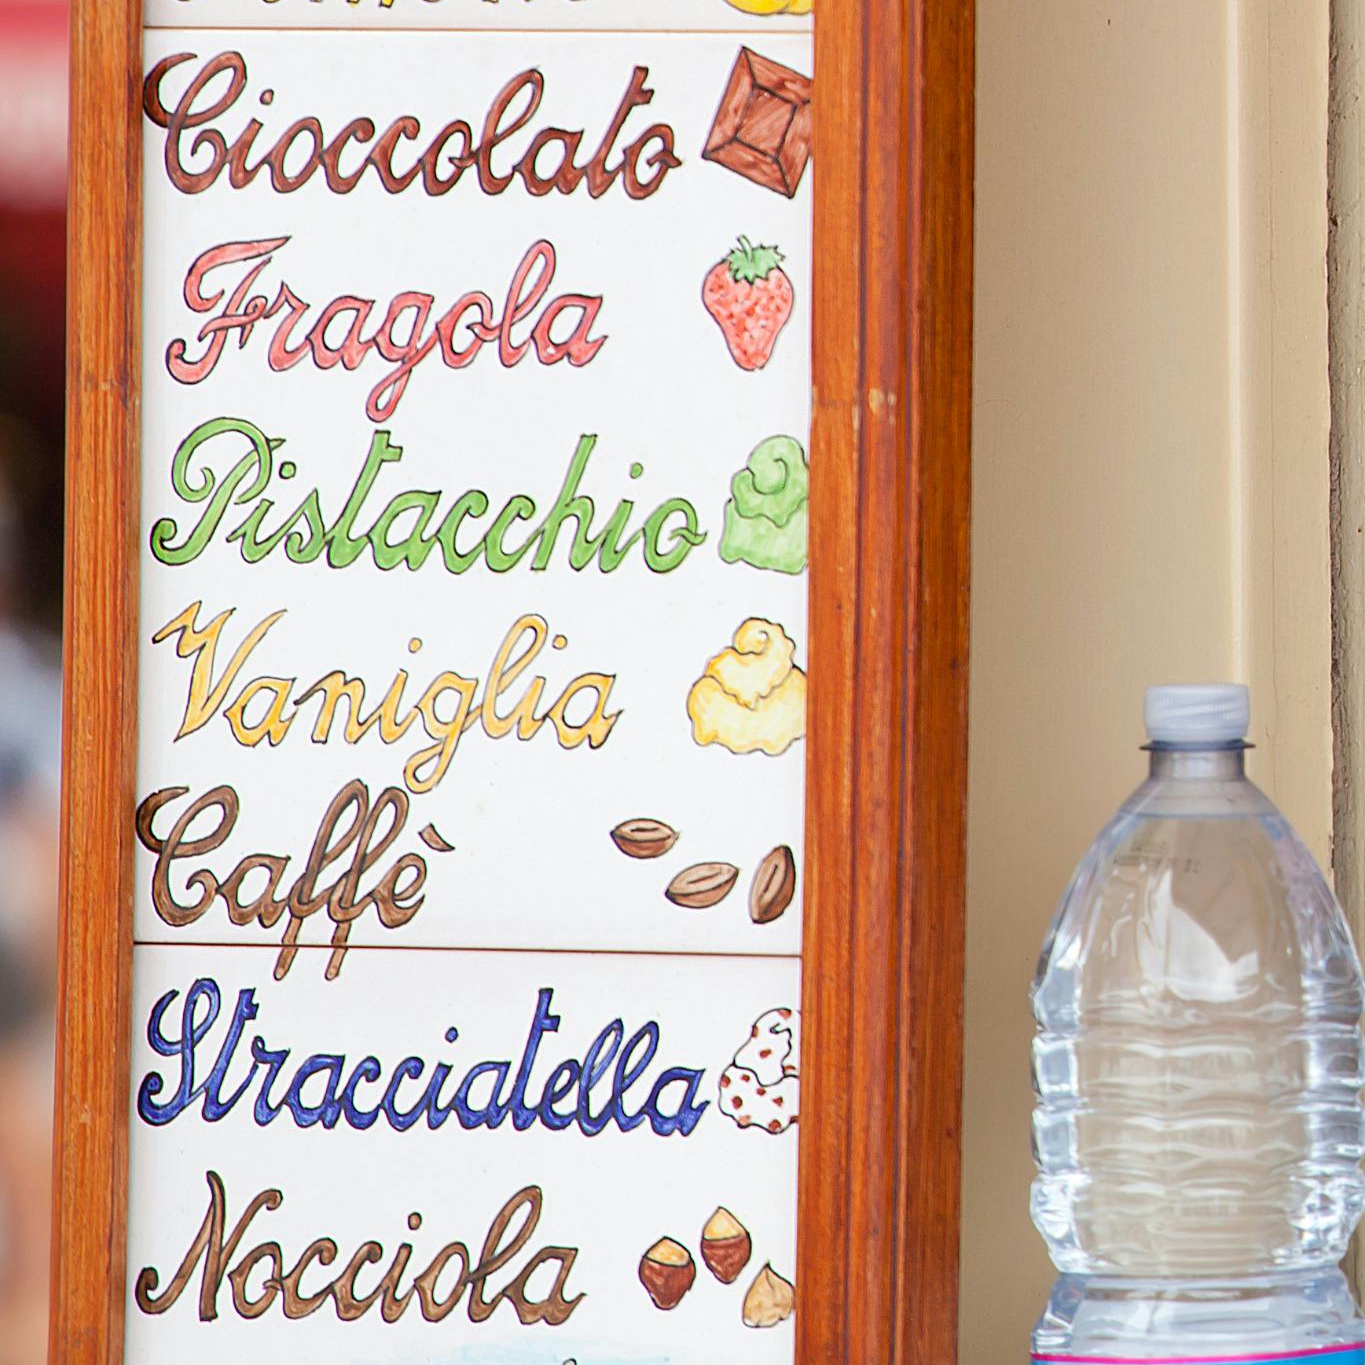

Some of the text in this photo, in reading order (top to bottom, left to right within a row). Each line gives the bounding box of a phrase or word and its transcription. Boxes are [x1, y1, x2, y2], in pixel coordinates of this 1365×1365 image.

[142, 50, 682, 201] Cioccolato
[165, 237, 608, 423] Fragola
[149, 417, 708, 575] Pistacchio
[152, 599, 624, 795] Vaniglia
[135, 778, 456, 981] Caffè
[136, 977, 711, 1137] Stracciatella
[134, 1171, 587, 1326] Nocciola
